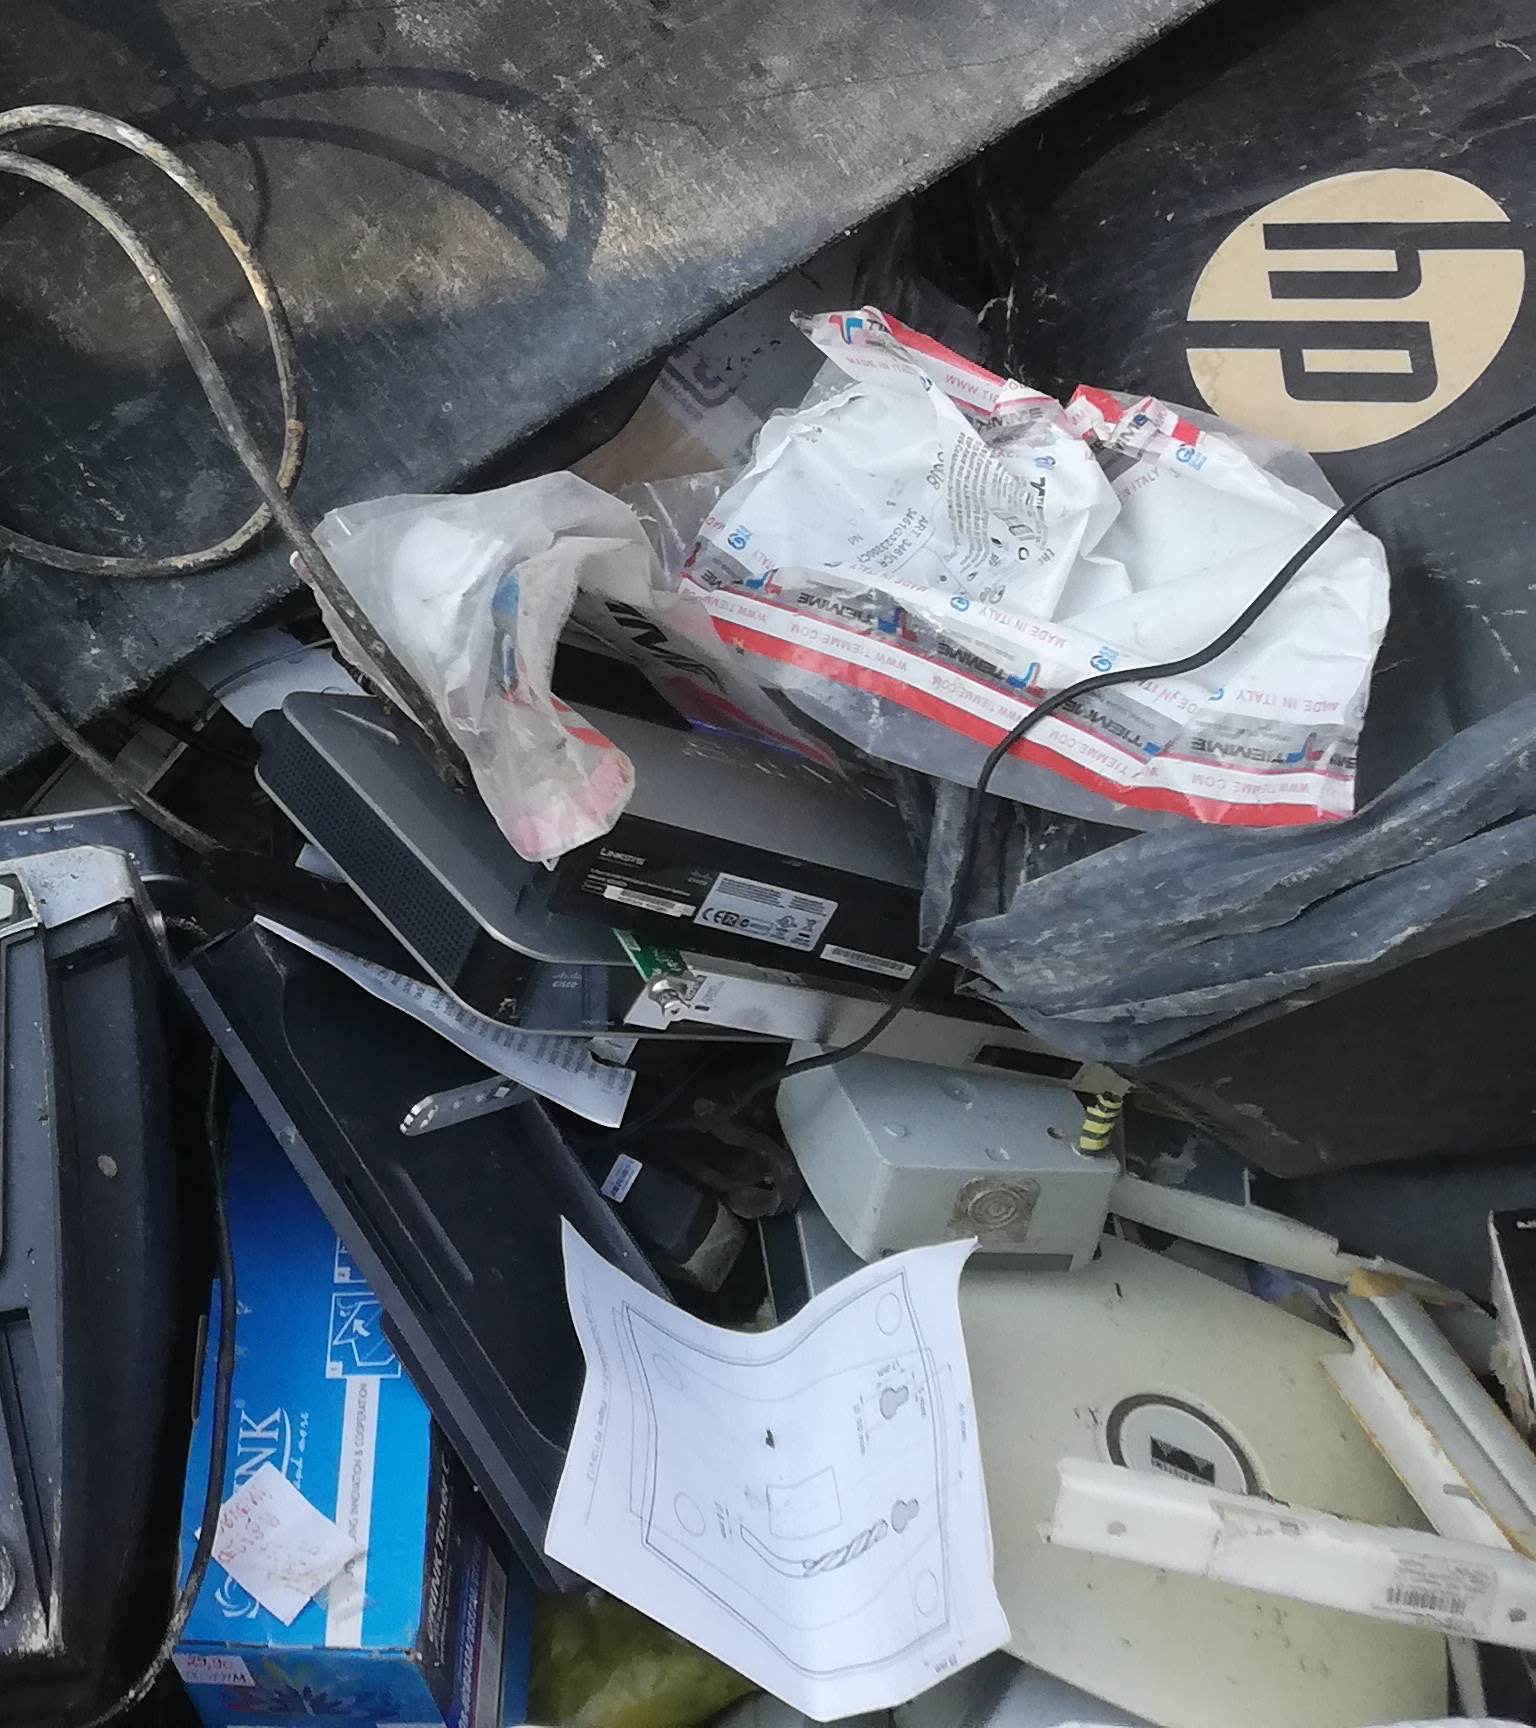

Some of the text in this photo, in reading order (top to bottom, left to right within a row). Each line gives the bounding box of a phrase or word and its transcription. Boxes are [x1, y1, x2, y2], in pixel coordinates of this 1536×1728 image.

[1185, 221, 1525, 404] hp
[797, 592, 875, 624] TIEMME
[1031, 628, 1066, 648] MADE
[938, 643, 1004, 678] TIEMME
[1237, 690, 1278, 707] ITALY
[1304, 699, 1338, 712] MADE
[1191, 738, 1286, 762] TIEMME
[354, 1383, 367, 1447] COOPERATION
[349, 1458, 362, 1515] INNOVATION
